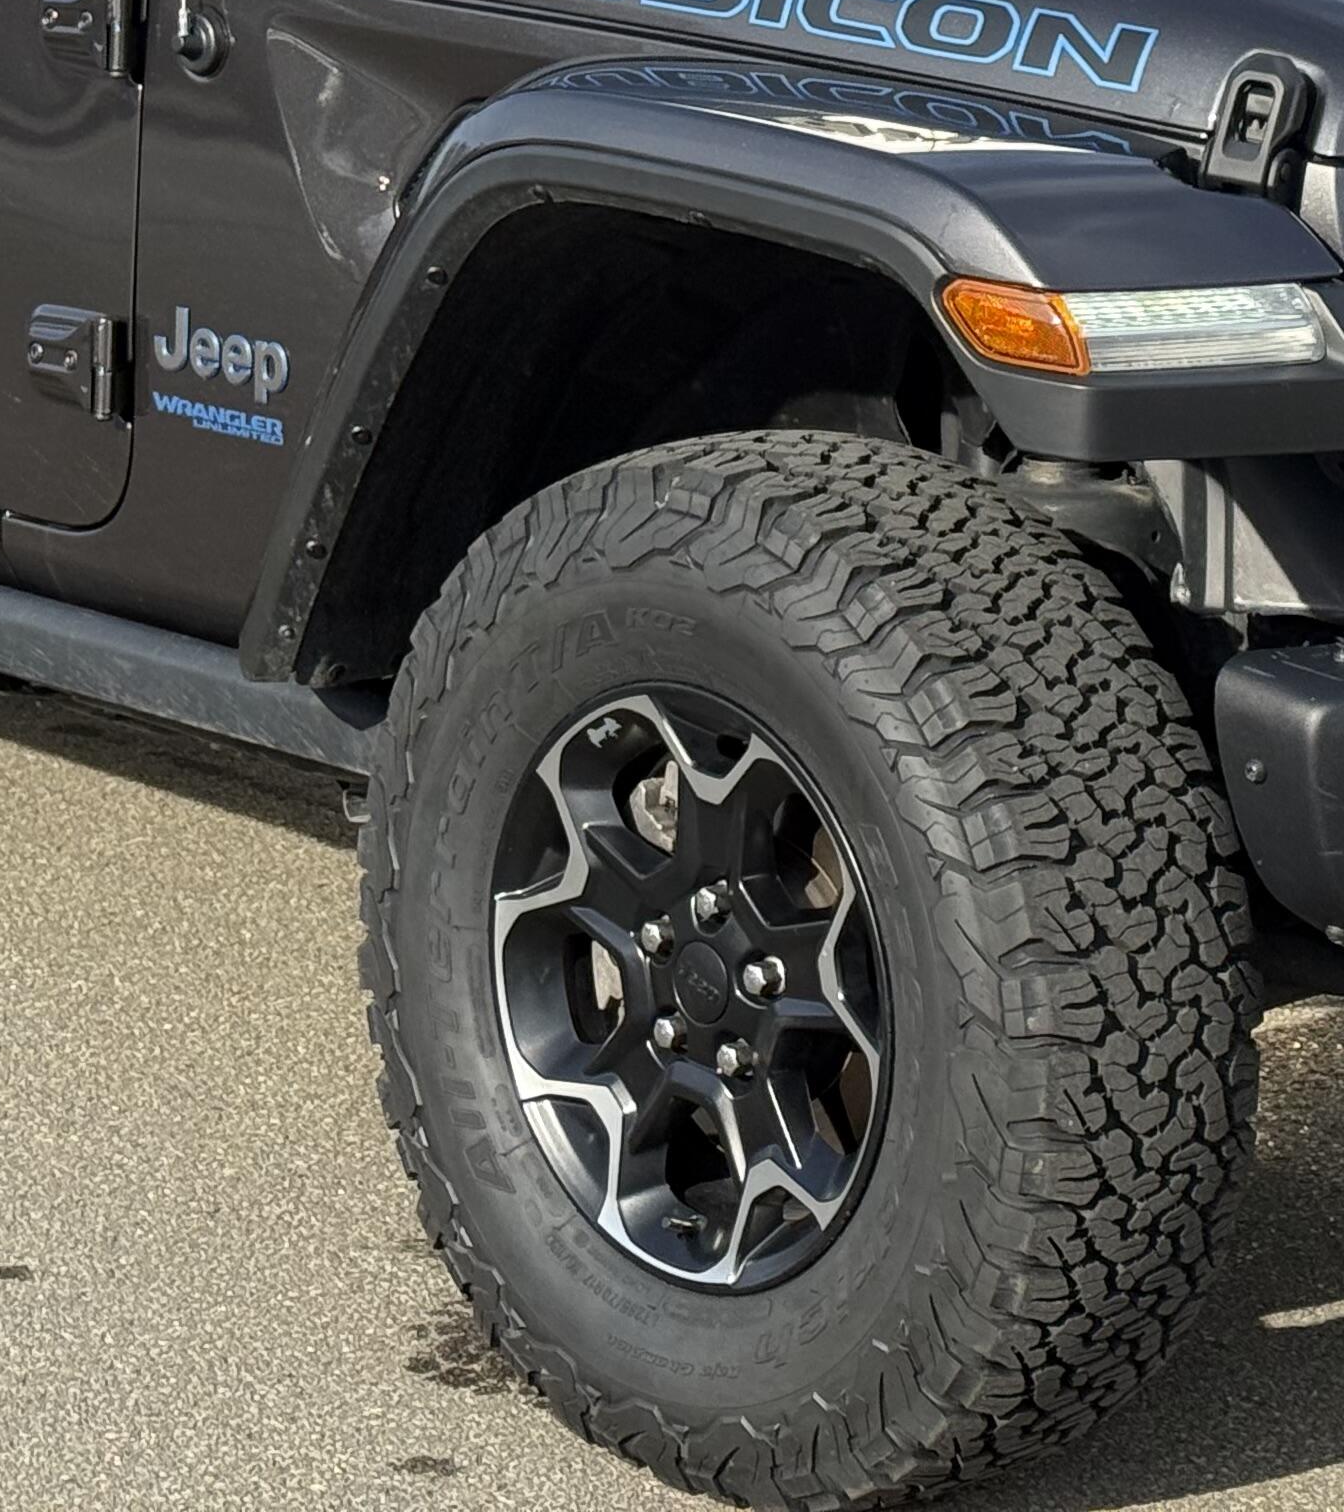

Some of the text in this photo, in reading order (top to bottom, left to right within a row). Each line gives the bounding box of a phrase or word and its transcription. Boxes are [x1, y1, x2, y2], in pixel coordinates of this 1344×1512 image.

[153, 305, 291, 405] Jeep
[152, 391, 284, 436] WRANGLER
[192, 417, 285, 447] UNLIMITED
